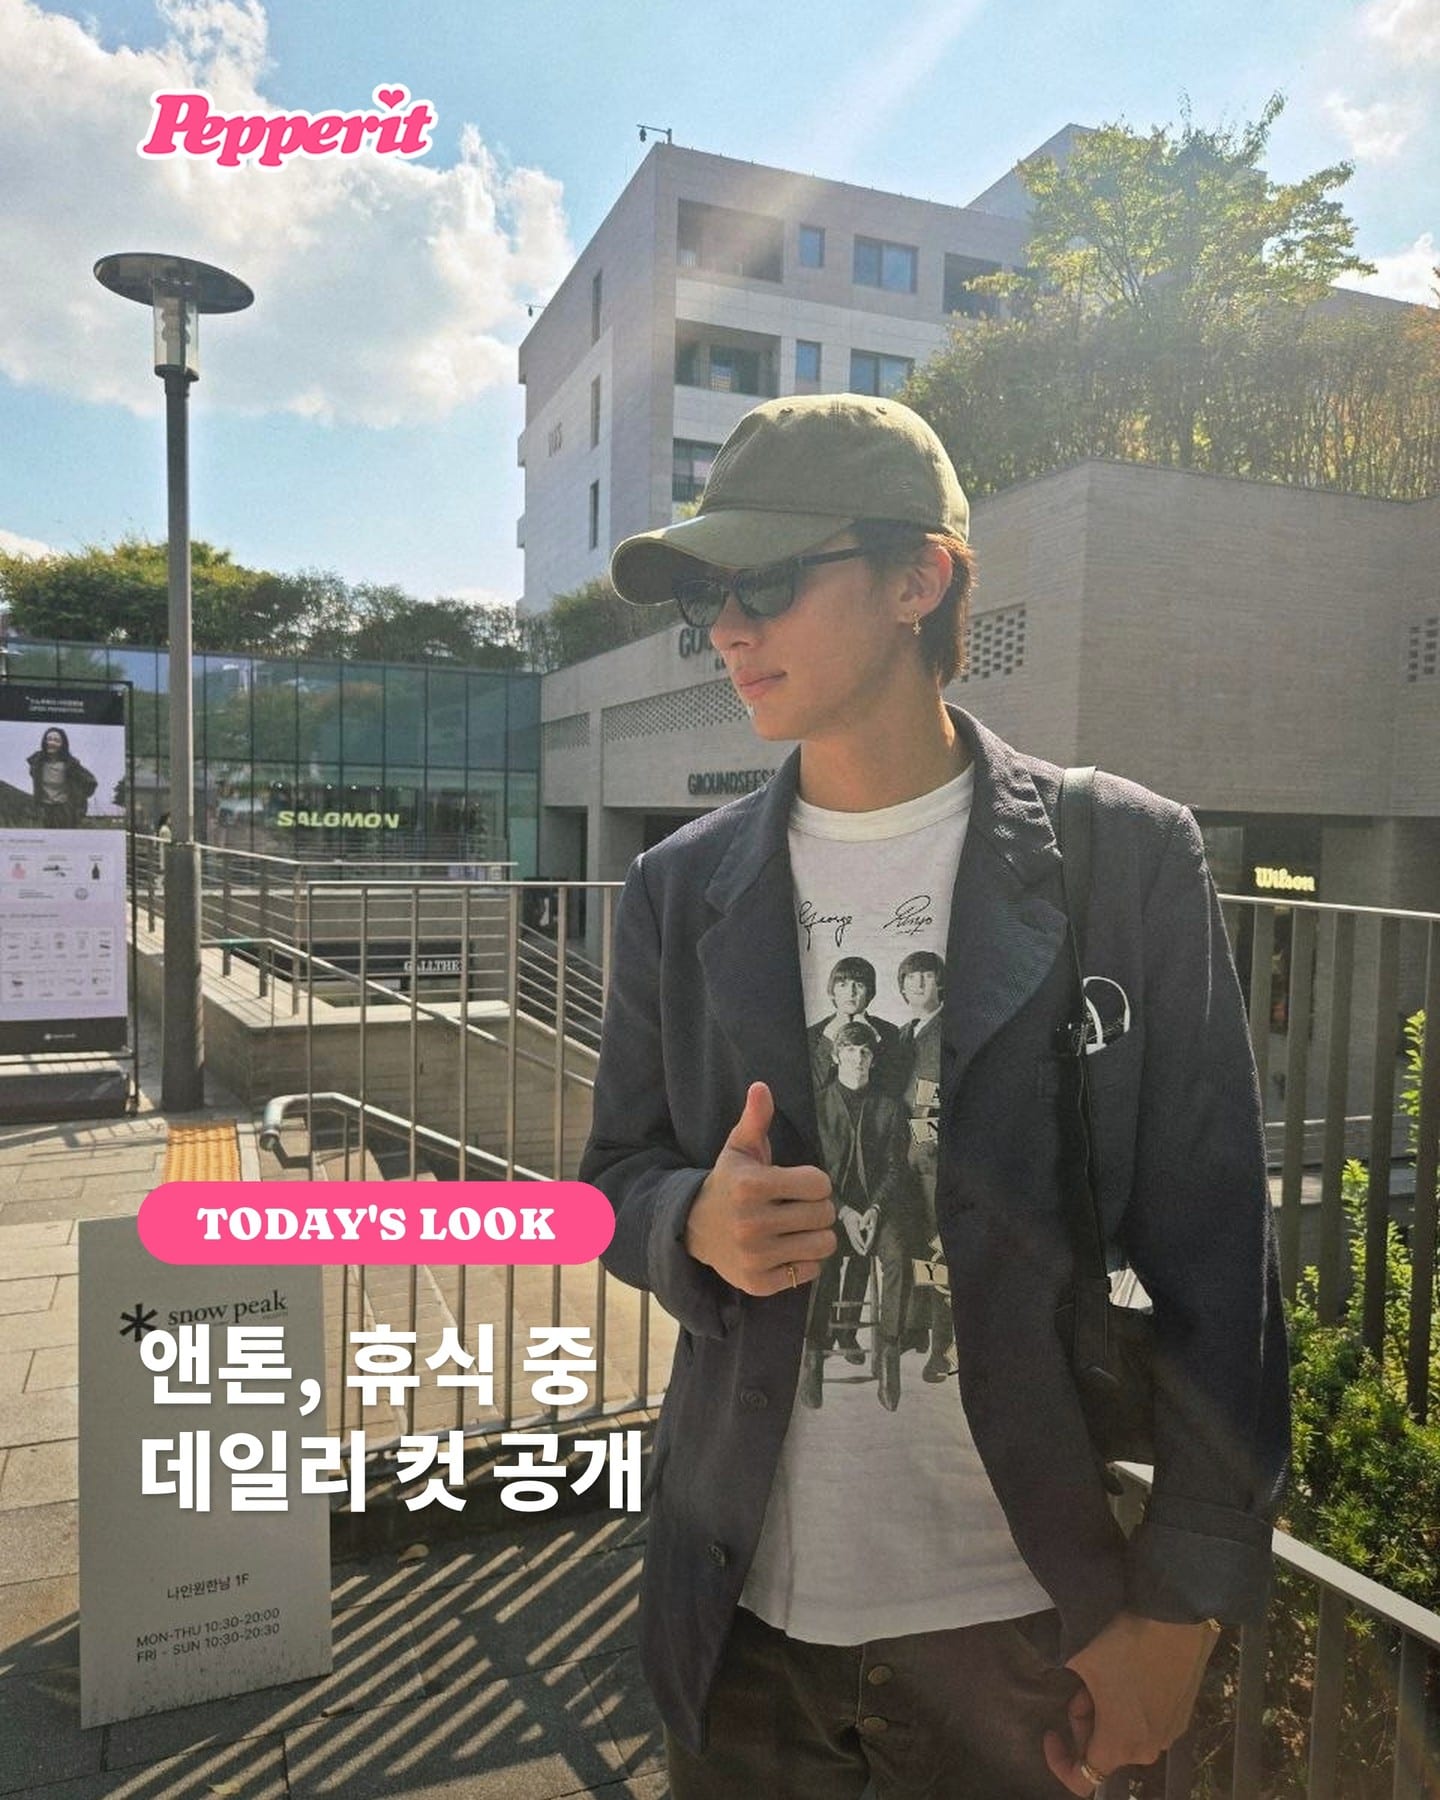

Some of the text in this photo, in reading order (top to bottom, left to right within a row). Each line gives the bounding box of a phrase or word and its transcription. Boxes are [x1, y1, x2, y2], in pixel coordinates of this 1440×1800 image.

[276, 809, 400, 829] SALOMON
[1254, 866, 1316, 892] Wilson
[799, 900, 854, 952] George
[167, 1289, 288, 1326] snow peak
[235, 1572, 250, 1588] 1F
[135, 1607, 281, 1648] MON-THU 10:30-20:00
[136, 1649, 157, 1663] FRI
[172, 1639, 200, 1656] SUN
[204, 1623, 281, 1647] 10:30-20:30
